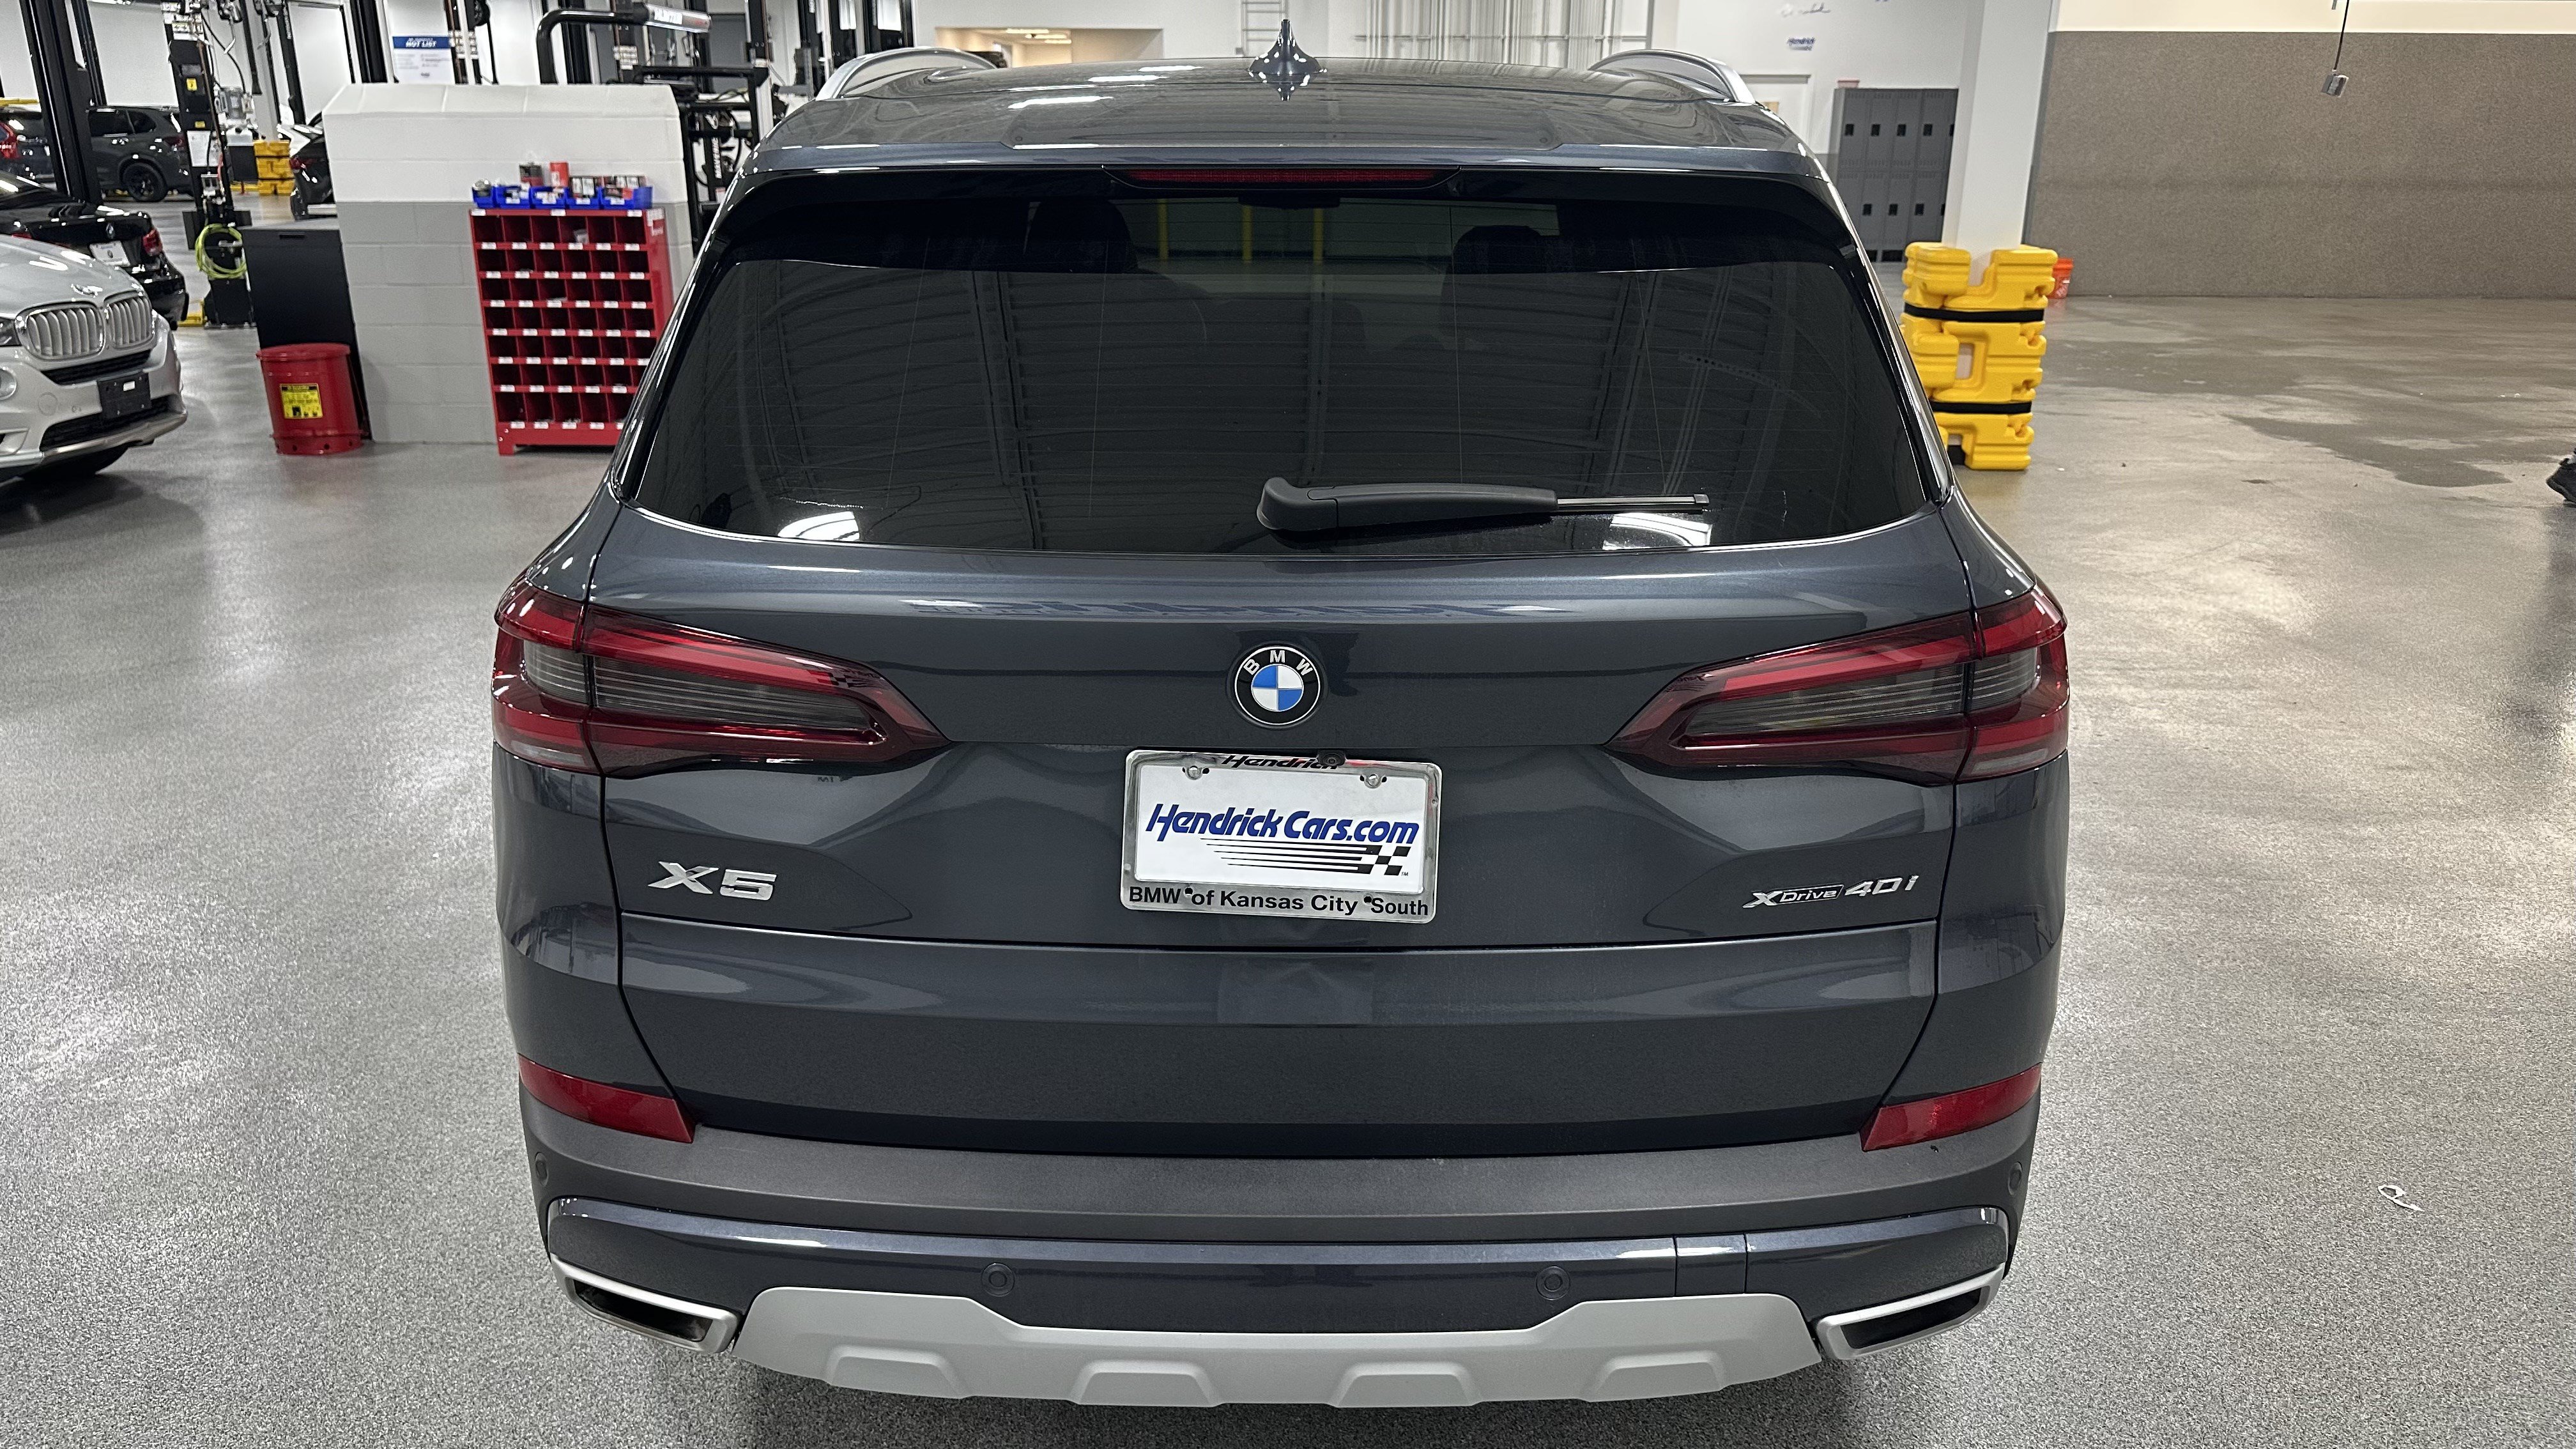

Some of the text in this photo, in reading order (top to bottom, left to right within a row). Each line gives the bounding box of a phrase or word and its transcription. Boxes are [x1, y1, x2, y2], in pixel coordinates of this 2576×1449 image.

[1243, 650, 1314, 675] BMW
[647, 861, 777, 901] X5
[1129, 886, 1429, 916] BMW of Kansas City South
